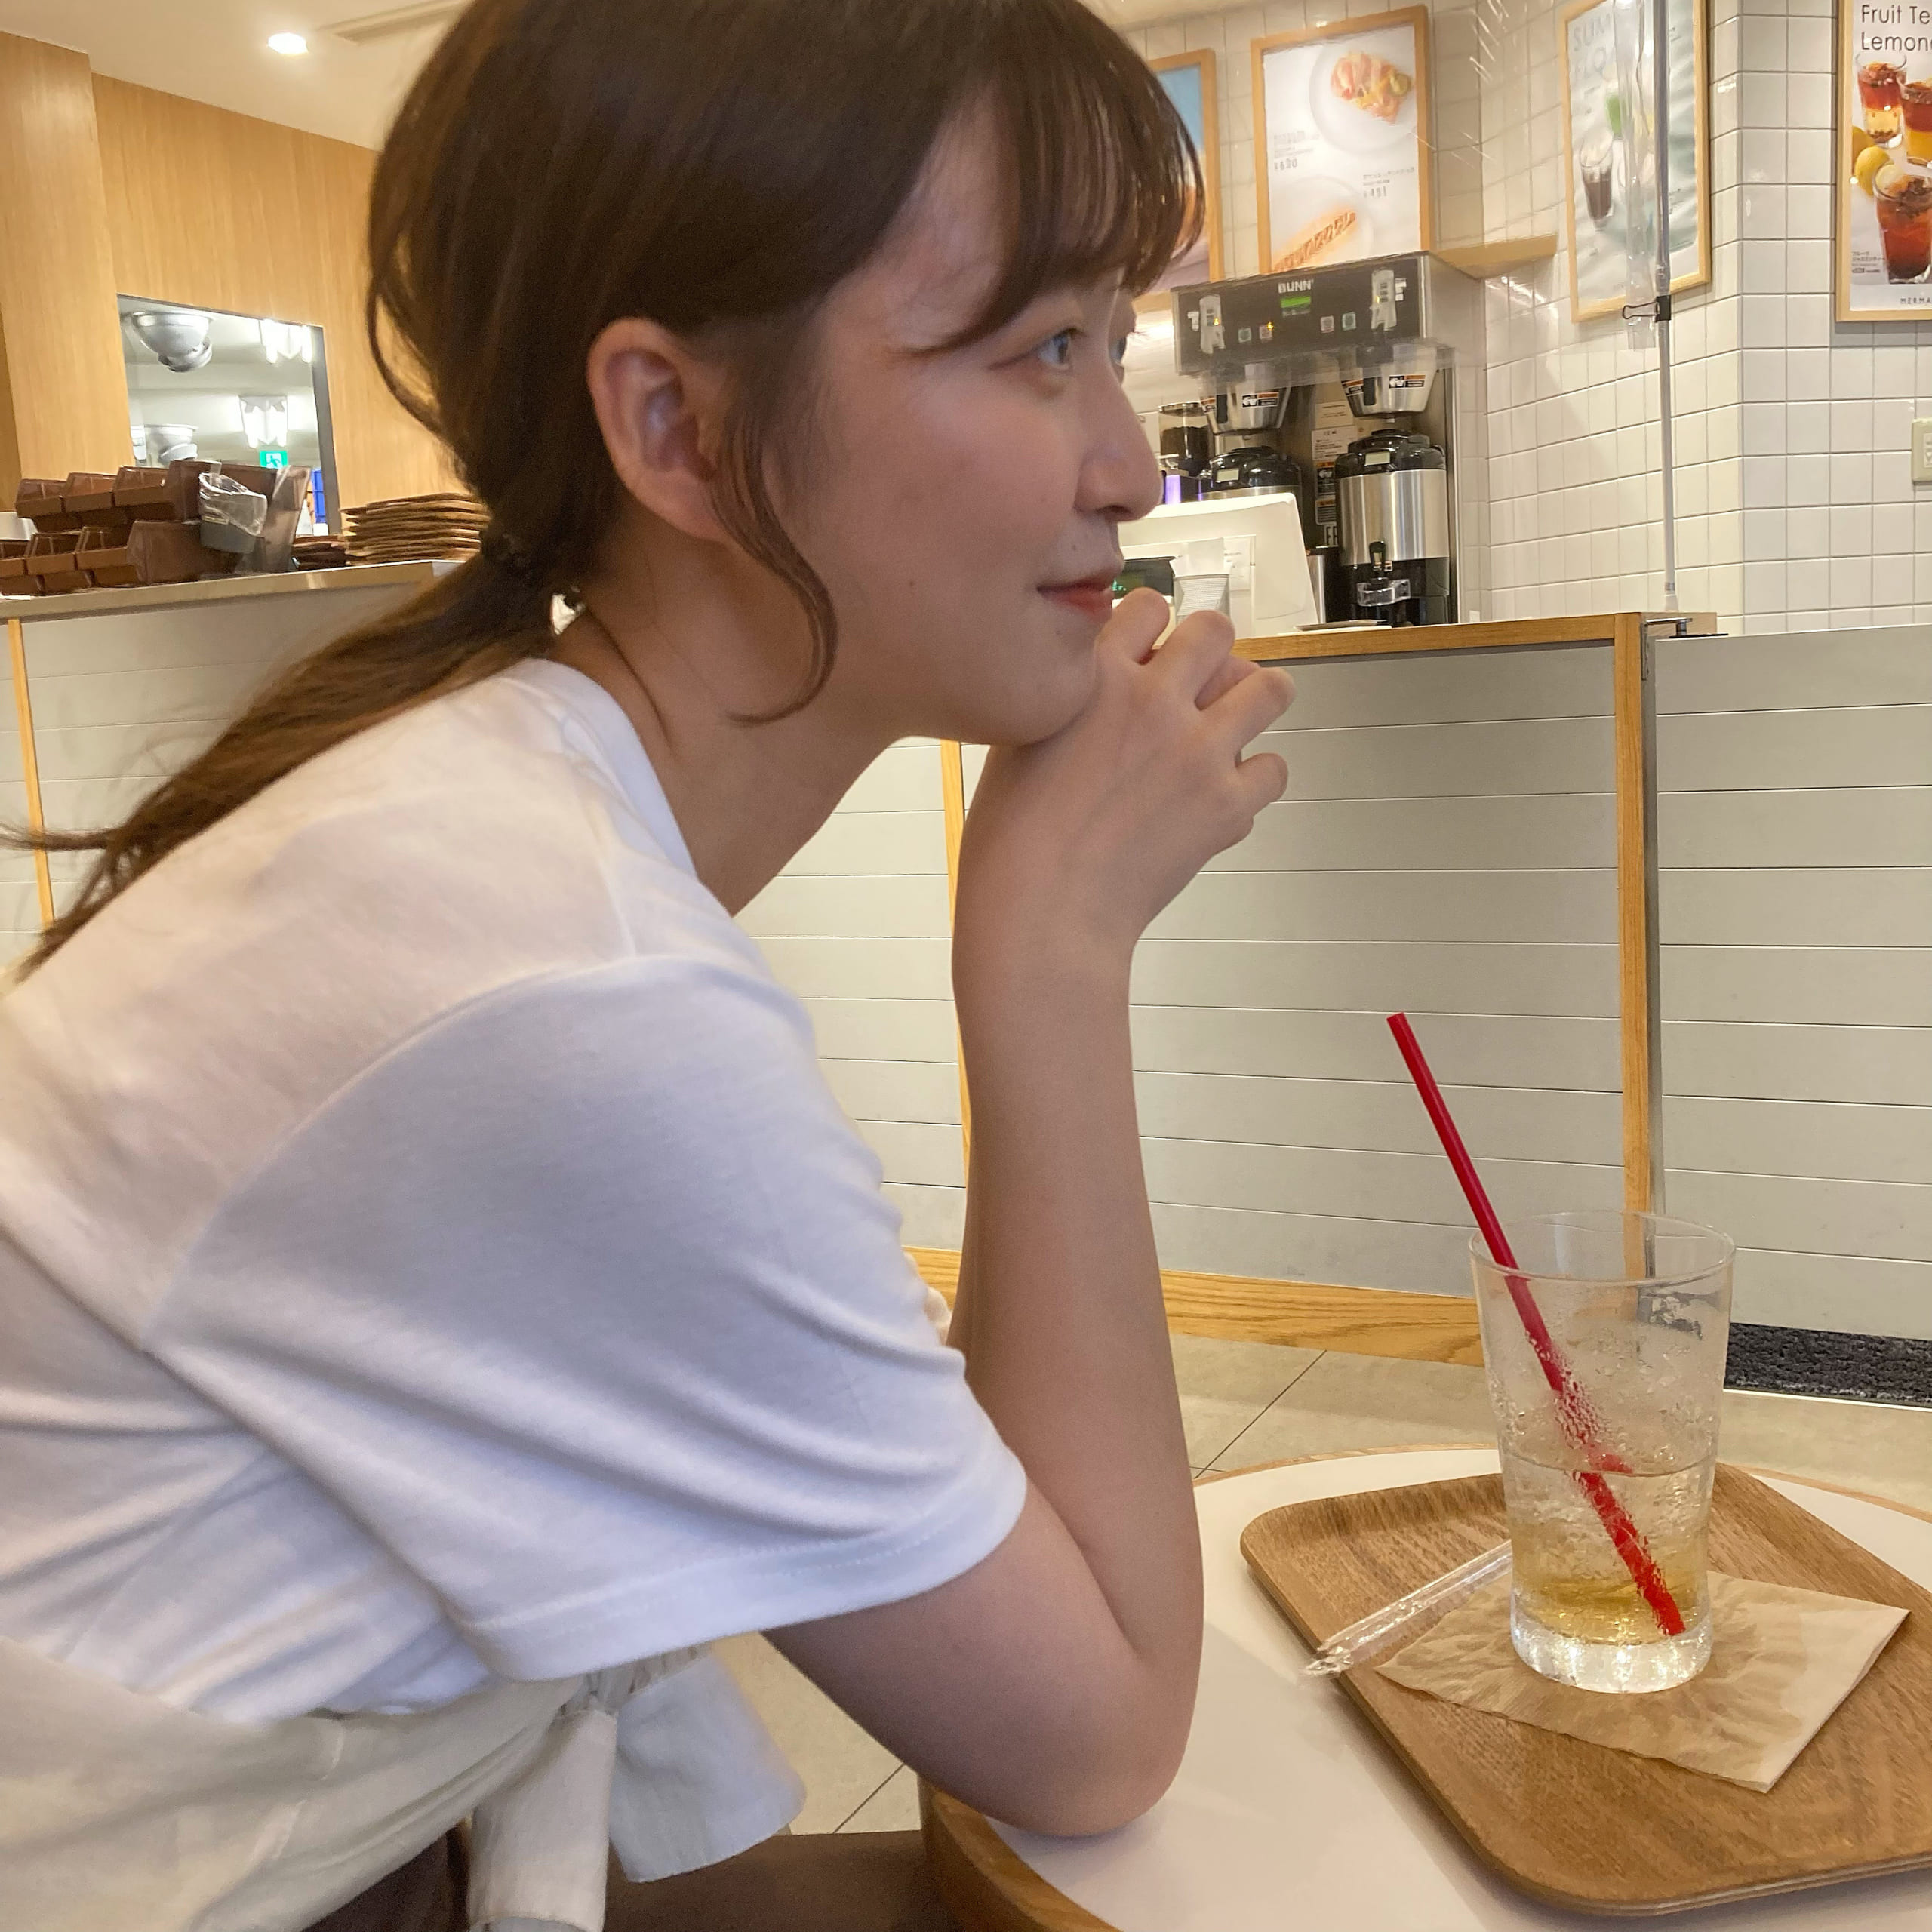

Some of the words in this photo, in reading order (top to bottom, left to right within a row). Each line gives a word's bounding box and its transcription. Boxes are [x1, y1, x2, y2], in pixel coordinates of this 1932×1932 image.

[1861, 4, 1903, 23] Fruit
[1909, 5, 1931, 25] Te
[1861, 32, 1932, 51] Lemon
